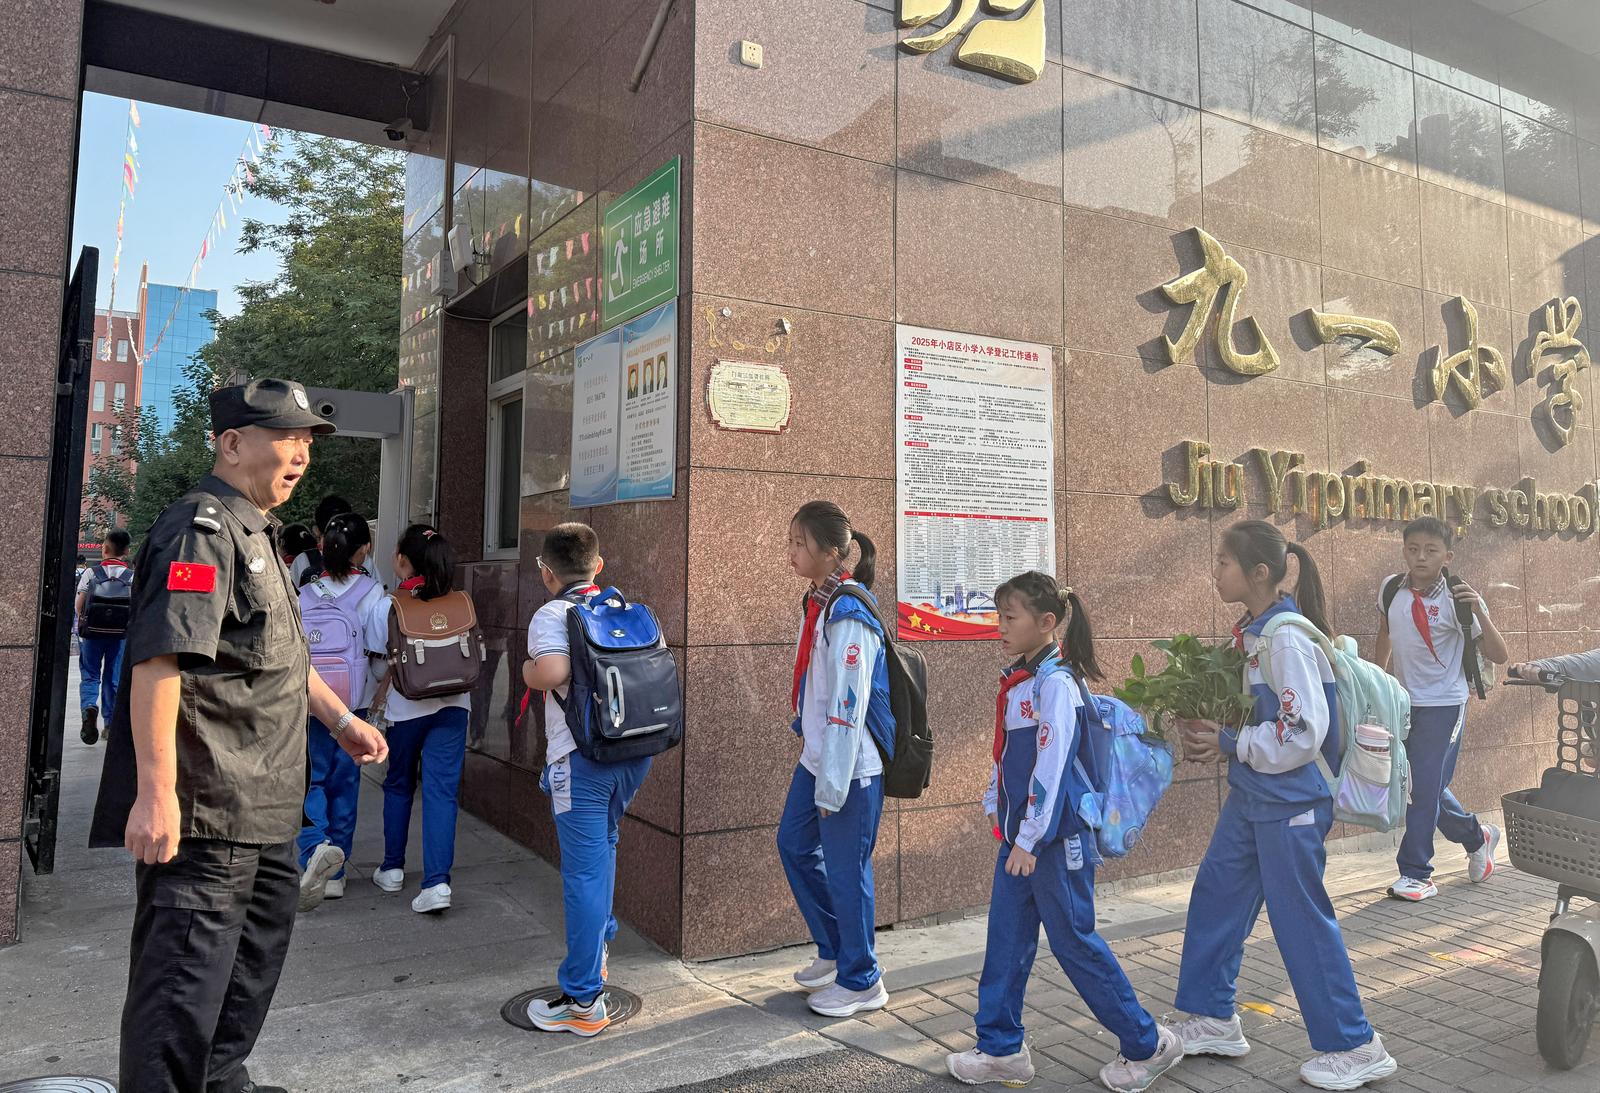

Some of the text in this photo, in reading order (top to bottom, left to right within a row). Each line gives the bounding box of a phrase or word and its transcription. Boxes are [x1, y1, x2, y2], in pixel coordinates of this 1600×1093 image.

[633, 191, 671, 238] 应急避难
[632, 259, 671, 290] EMERGENCY SHELTER
[911, 336, 1040, 363] 2025年小店区小学入学登记工作通告
[1162, 226, 1590, 447] 九一小学
[1168, 440, 1244, 509] Jiu
[1250, 447, 1308, 514] Yi
[1307, 460, 1477, 539] primary
